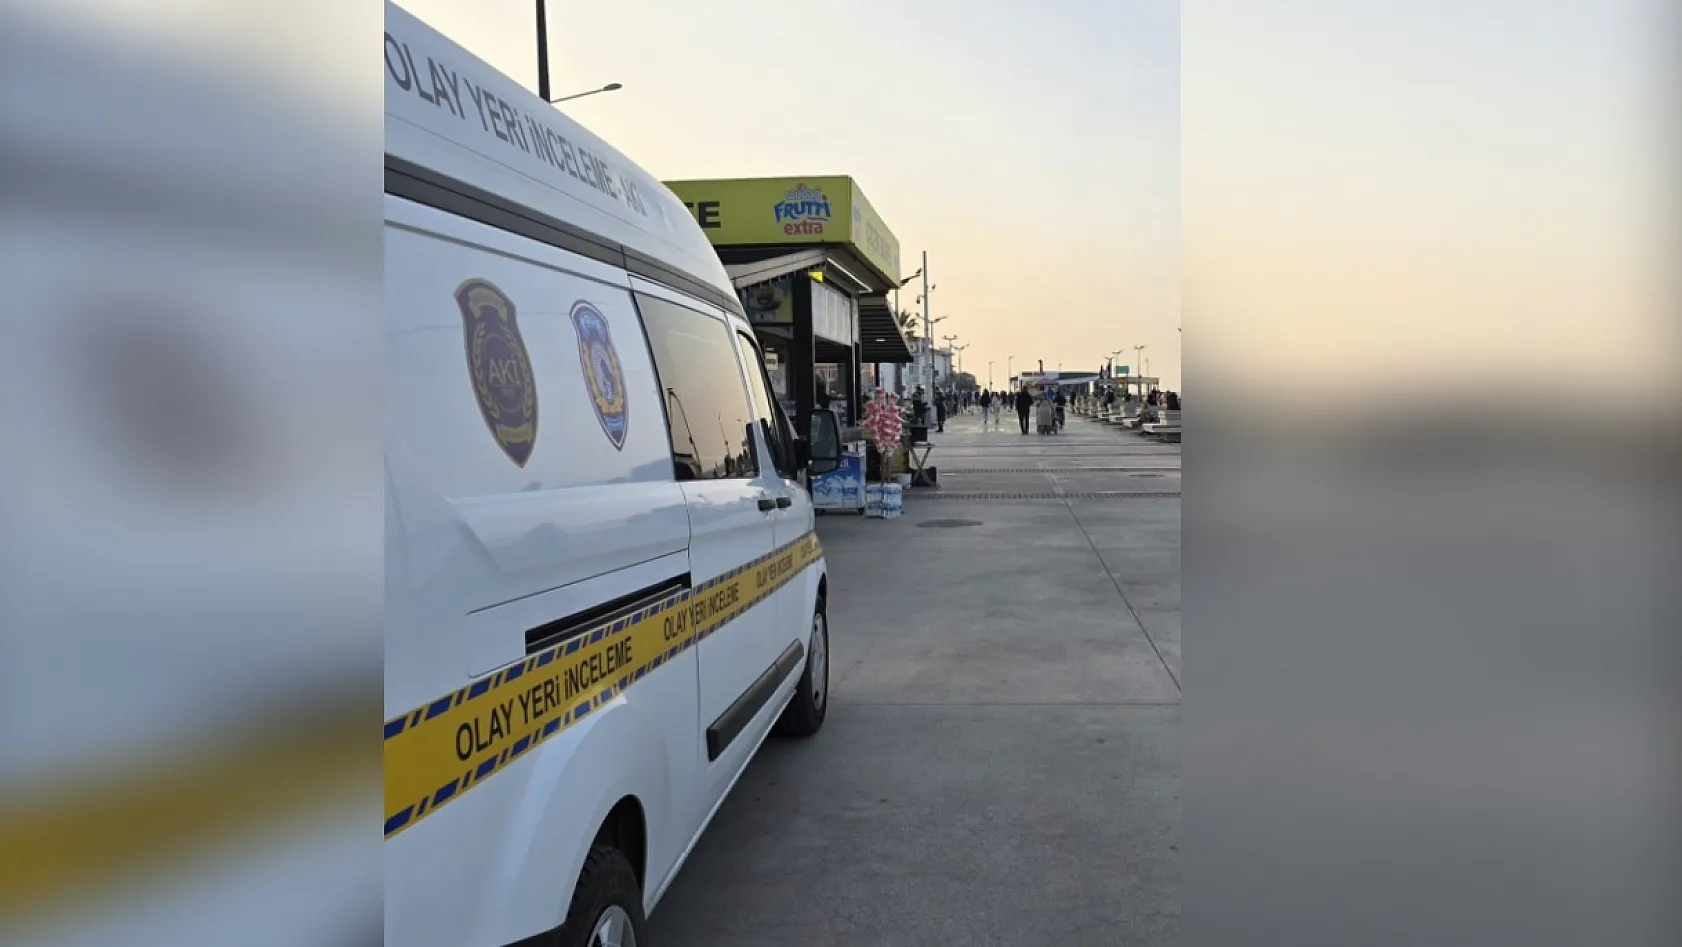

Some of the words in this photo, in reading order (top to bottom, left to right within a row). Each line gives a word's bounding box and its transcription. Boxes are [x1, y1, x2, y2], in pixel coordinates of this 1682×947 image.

[384, 31, 465, 120] OLAY
[784, 220, 823, 236] extra
[663, 608, 688, 641] OLAY
[455, 698, 514, 762] OLAY
